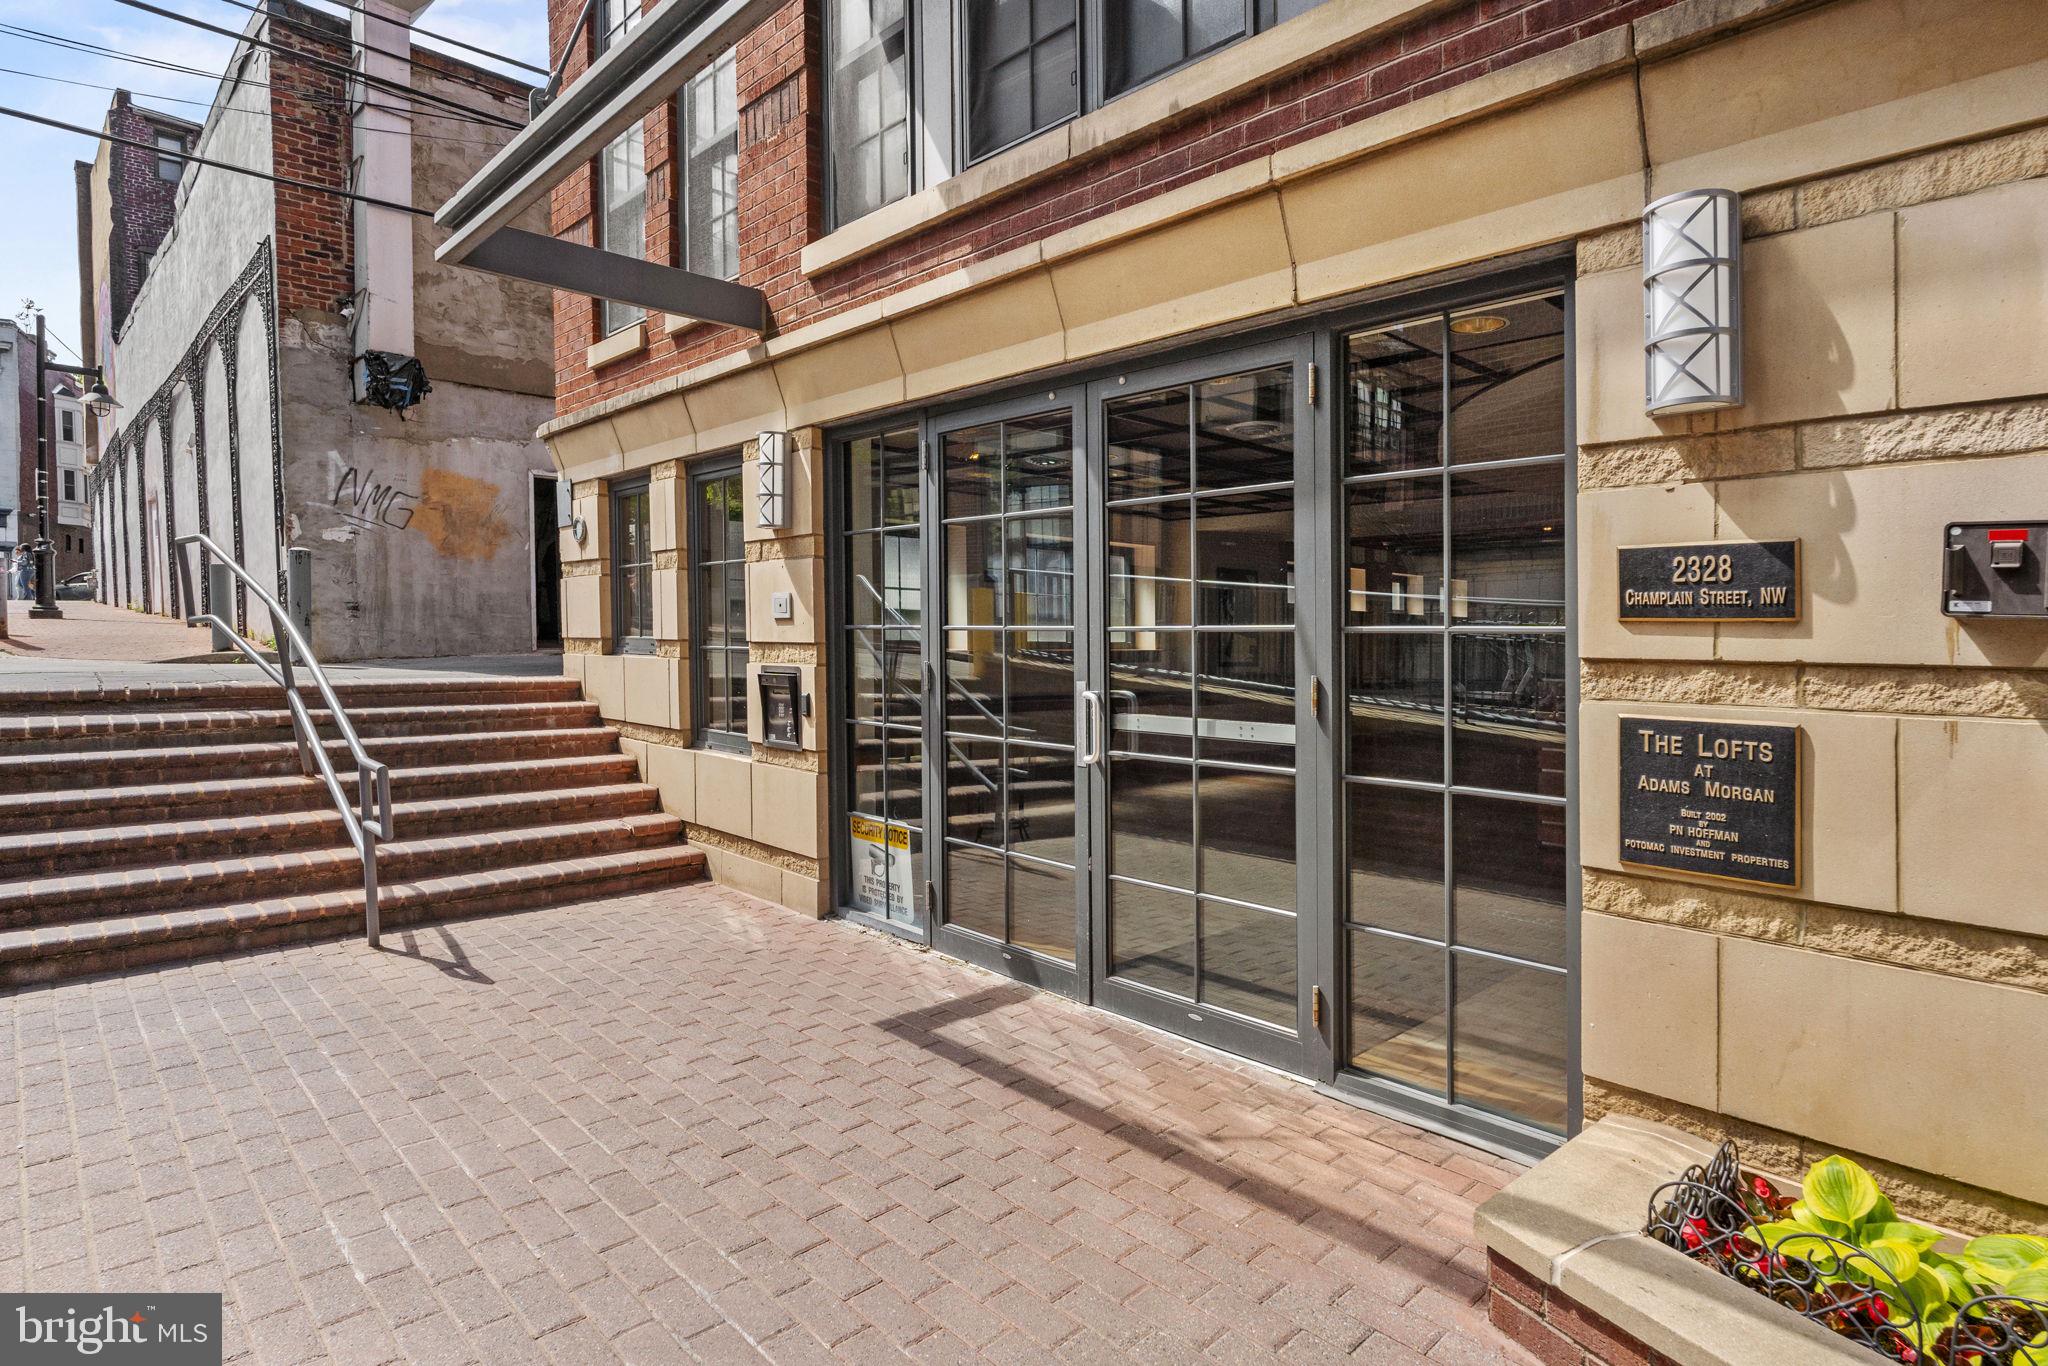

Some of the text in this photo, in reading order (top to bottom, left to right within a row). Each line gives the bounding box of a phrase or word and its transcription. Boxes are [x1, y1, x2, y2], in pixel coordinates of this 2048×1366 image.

[1672, 554, 1733, 583] 2328
[1625, 586, 1788, 608] CHAMPLAIN STREET, NW
[1638, 729, 1774, 763] THE LOFTS
[1693, 763, 1714, 779] AT
[1637, 774, 1775, 804] ADAMS MORGAN
[1680, 808, 1728, 822] BUILT 2002
[1698, 820, 1710, 829] BY
[852, 820, 908, 846] SECURITY OTICE
[1669, 824, 1740, 843] PN HOFFMAN
[1695, 839, 1711, 849] AND
[1624, 838, 1790, 870] POTOMAC INVESTMENT PROPERTIES
[863, 875, 901, 893] THIS PROERTY
[896, 894, 904, 904] BY
